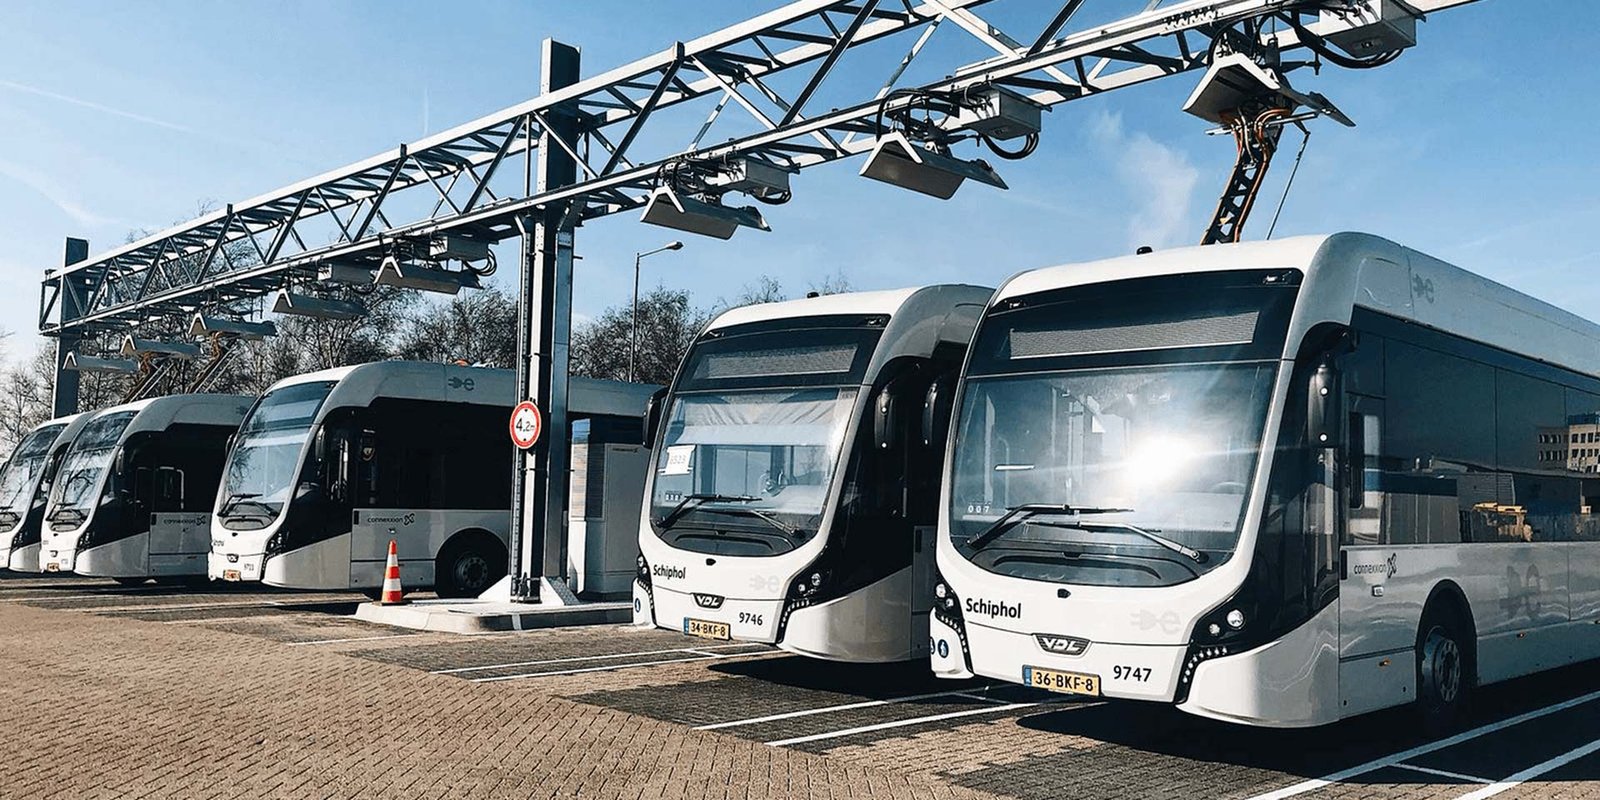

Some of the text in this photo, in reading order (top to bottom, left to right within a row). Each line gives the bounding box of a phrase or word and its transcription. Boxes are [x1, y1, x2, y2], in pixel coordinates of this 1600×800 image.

[653, 564, 686, 580] Schiphol
[696, 595, 721, 607] VDL
[965, 597, 1022, 619] Schiphol
[739, 612, 763, 626] 9746
[690, 622, 726, 638] 34-BKF-8
[1042, 636, 1080, 652] VDL
[1035, 671, 1094, 692] 36-BKF-8
[1113, 665, 1152, 683] 9747
